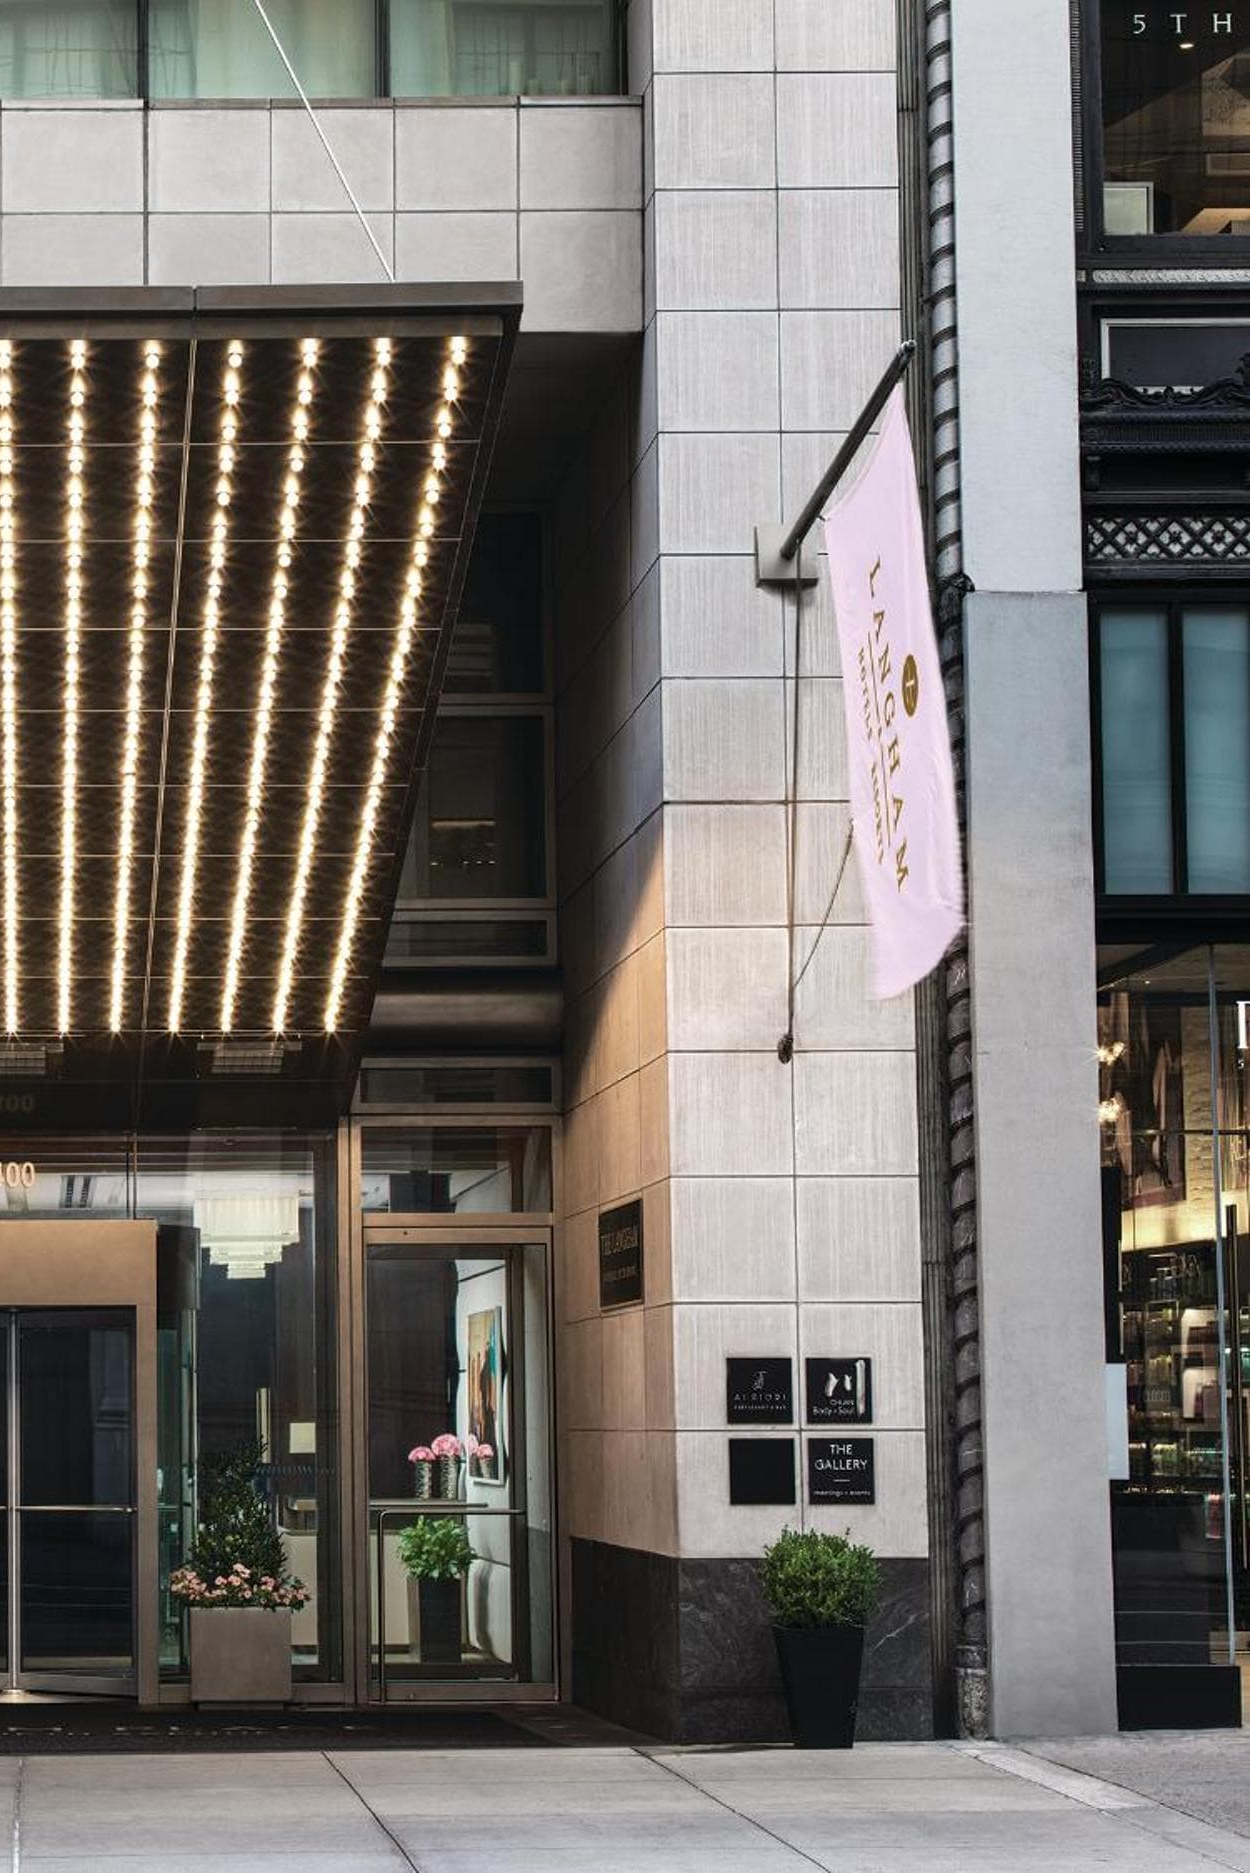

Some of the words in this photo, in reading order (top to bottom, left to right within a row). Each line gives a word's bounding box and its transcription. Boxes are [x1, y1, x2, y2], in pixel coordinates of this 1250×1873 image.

[869, 556, 909, 893] LANGHAM
[830, 1444, 852, 1455] THE
[814, 1459, 868, 1471] GALLERY
